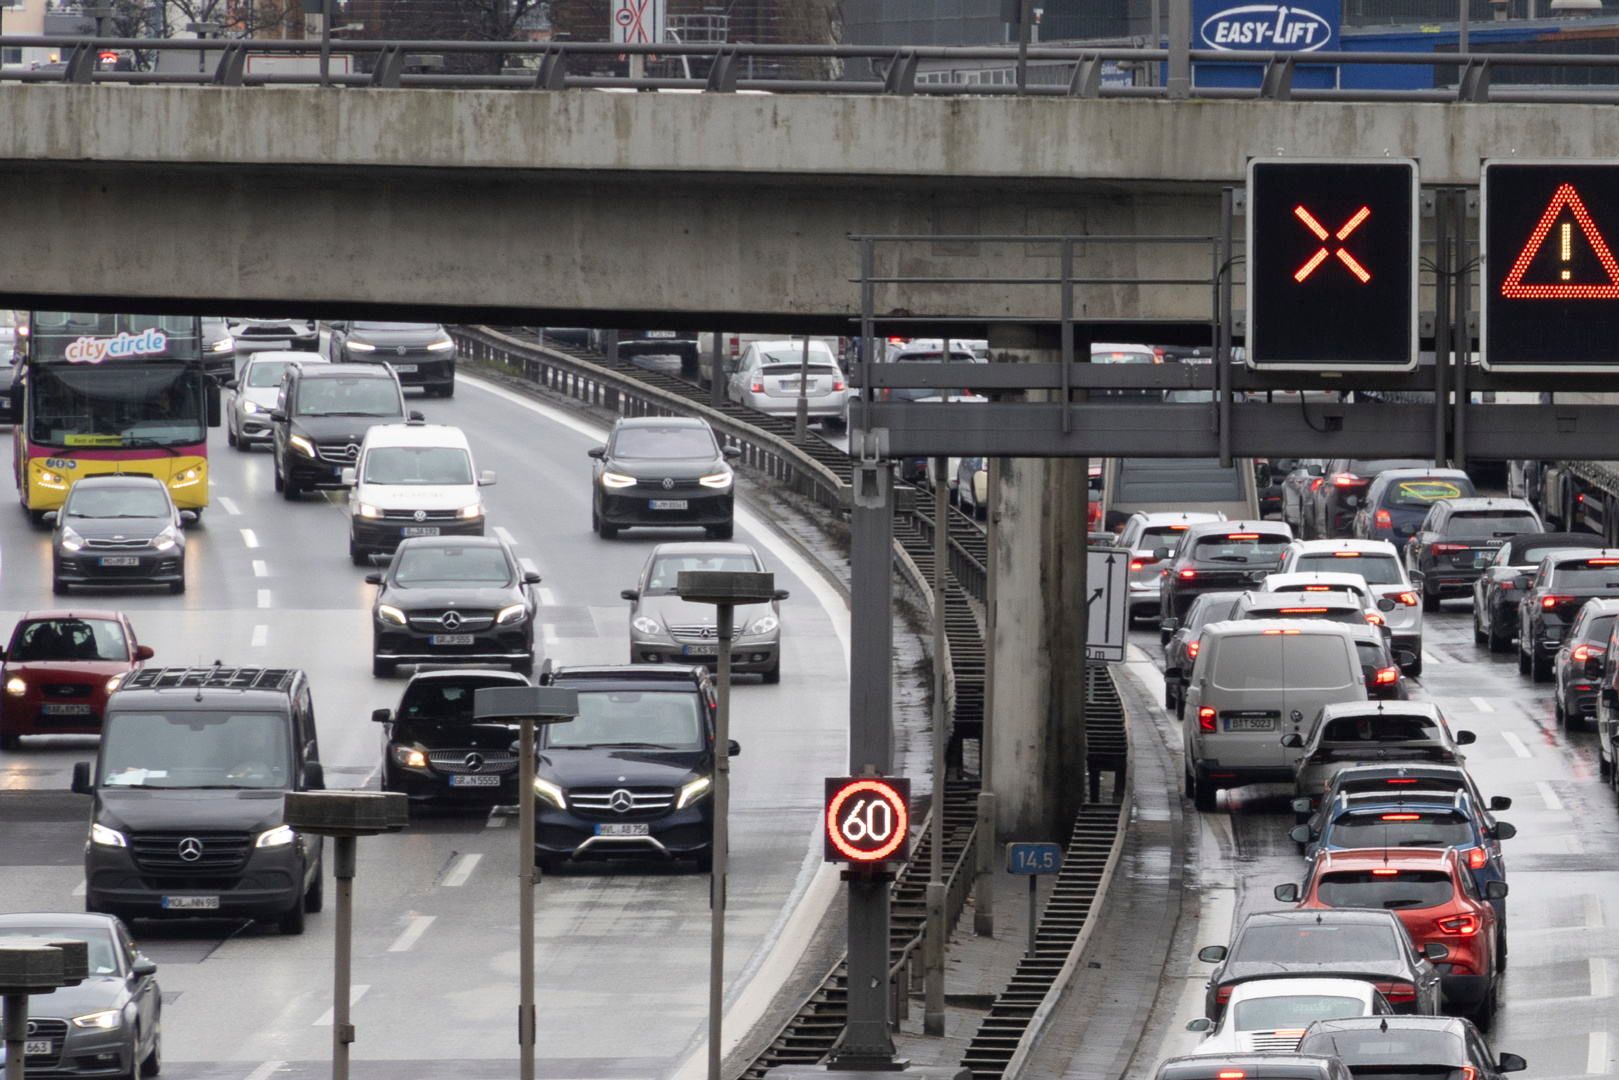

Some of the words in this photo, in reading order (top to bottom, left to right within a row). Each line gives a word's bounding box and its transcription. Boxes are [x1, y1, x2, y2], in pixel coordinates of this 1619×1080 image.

[1215, 17, 1319, 44] EASY-LIFT
[71, 339, 107, 361] city
[111, 334, 154, 353] circle
[1232, 718, 1238, 729] B
[1250, 718, 1271, 729] 5023
[478, 776, 499, 785] 5555
[843, 799, 891, 842] 60
[1018, 851, 1054, 868] 14.5
[27, 1041, 49, 1052] 663
